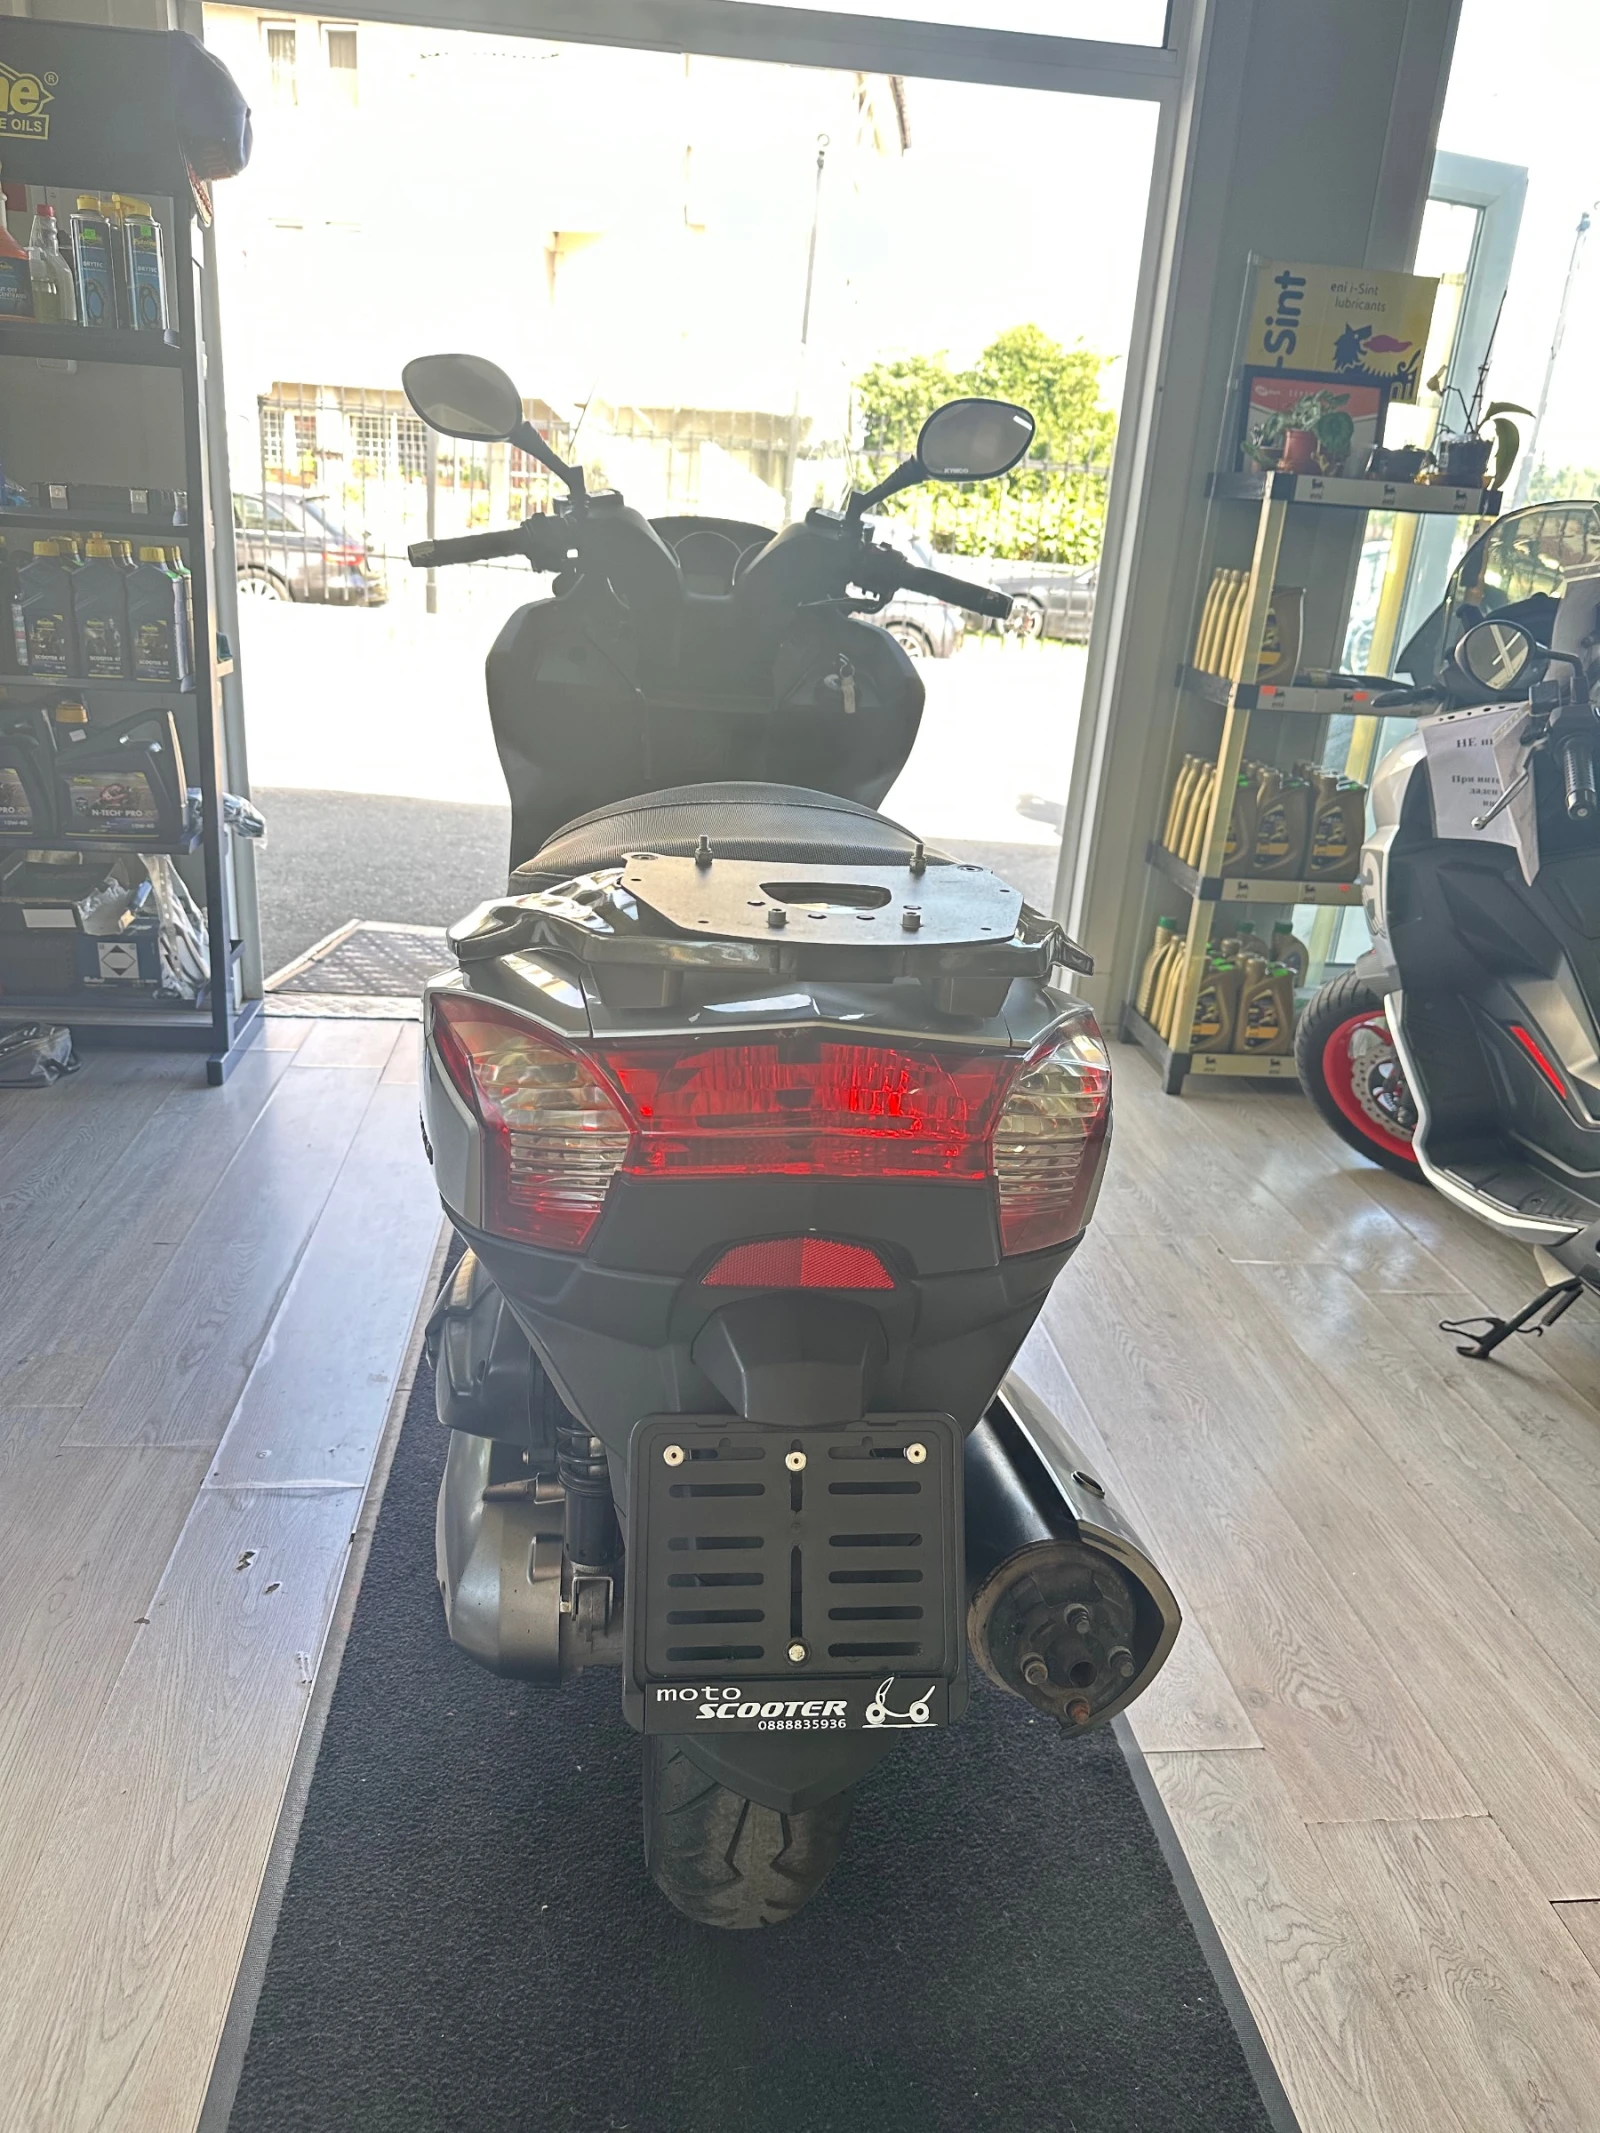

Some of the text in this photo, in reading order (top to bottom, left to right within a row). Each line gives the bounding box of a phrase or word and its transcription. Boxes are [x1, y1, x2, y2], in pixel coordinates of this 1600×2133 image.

[11, 119, 42, 132] OILS
[138, 265, 157, 273] DRYTEC
[1330, 281, 1379, 296] eni i-Sint
[1335, 298, 1386, 312] lubricants
[1264, 270, 1306, 369] -Sint
[1457, 737, 1477, 748] НЕ
[1452, 775, 1474, 785] При
[125, 809, 143, 817] PRO
[656, 1685, 742, 1702] moto
[695, 1700, 848, 1719] SCOOTER
[757, 1719, 847, 1731] 0888835936
